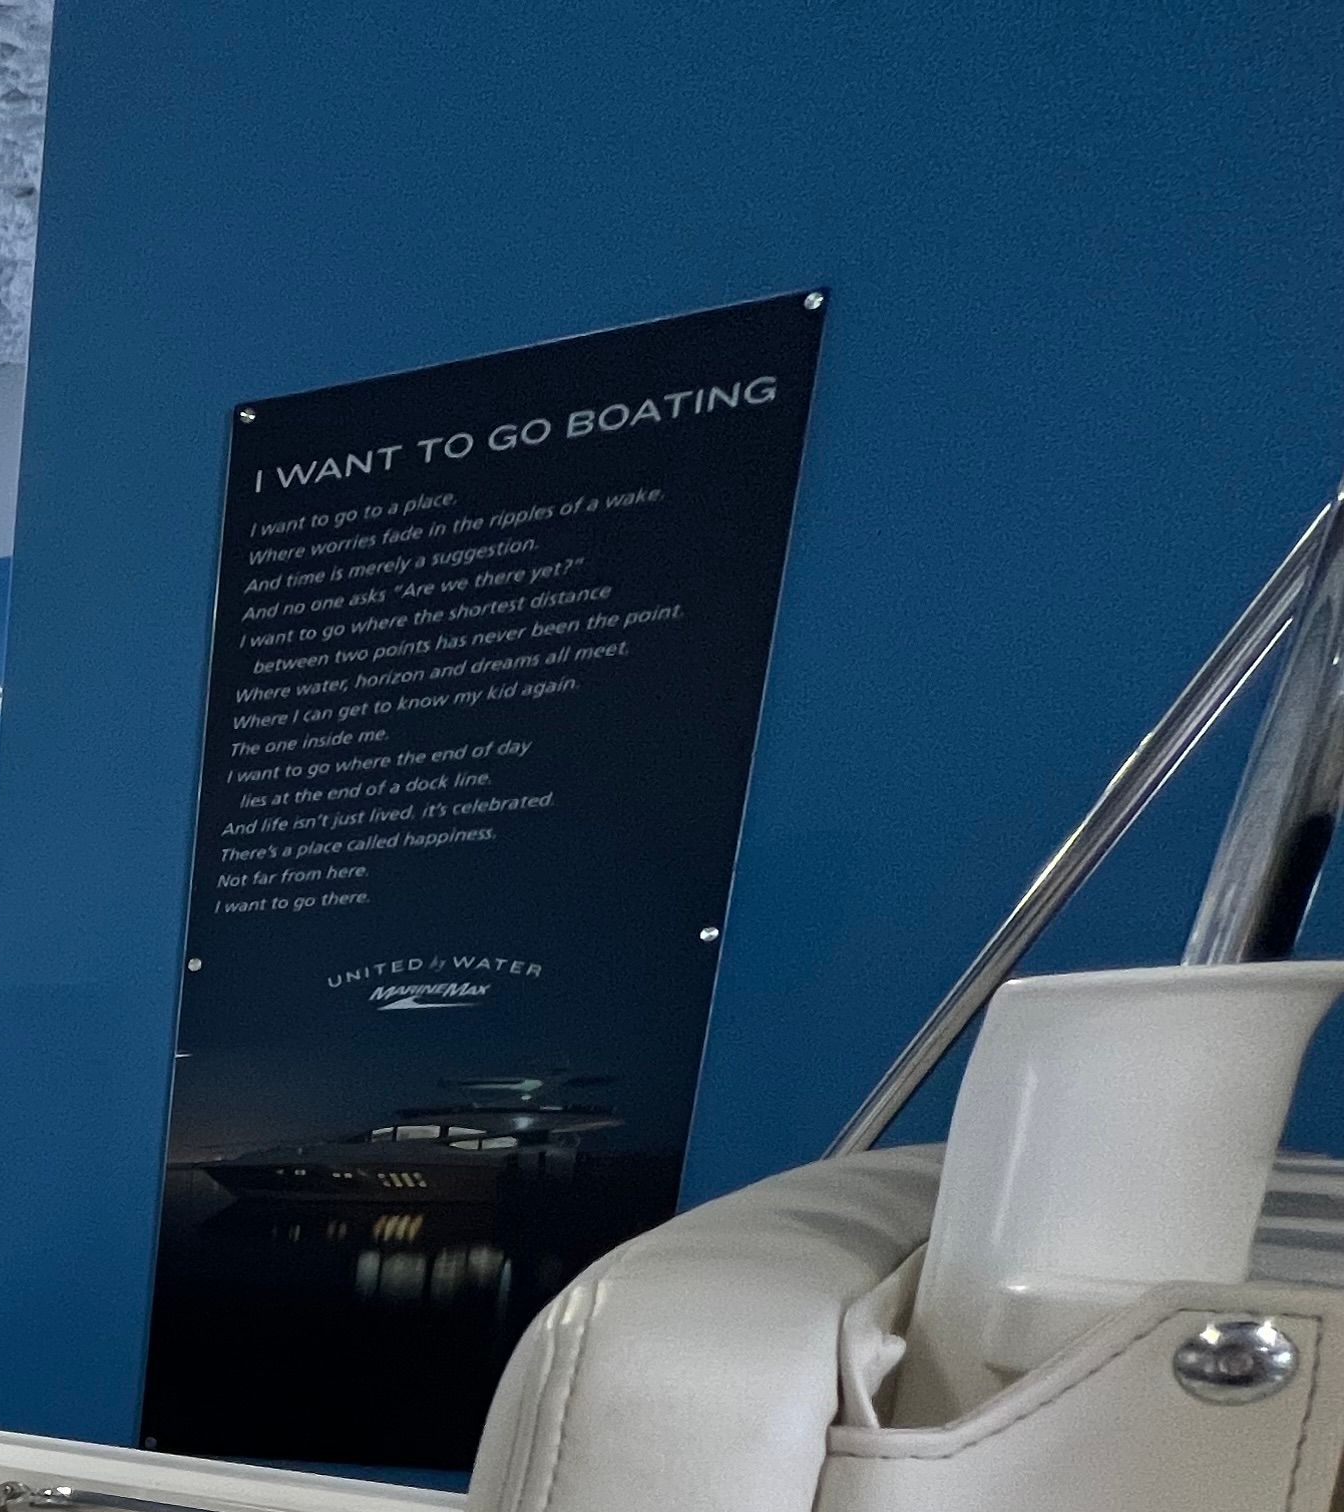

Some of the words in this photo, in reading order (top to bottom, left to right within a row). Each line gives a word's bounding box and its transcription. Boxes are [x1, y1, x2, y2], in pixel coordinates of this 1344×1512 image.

[255, 469, 263, 493] I
[276, 445, 403, 488] WANT
[417, 432, 474, 464] TO
[487, 418, 552, 451] GO
[566, 376, 777, 438] BOATING
[248, 545, 305, 566] Where
[310, 534, 376, 556] worries
[382, 525, 423, 546] fade
[428, 521, 446, 537] in
[453, 516, 484, 534] the
[489, 504, 554, 530] ripples
[559, 496, 585, 516] of
[586, 498, 599, 512] a
[250, 522, 258, 537] I
[262, 516, 306, 537] want
[311, 514, 330, 528] to
[334, 509, 358, 528] go
[364, 505, 382, 519] to
[387, 503, 399, 515] a
[244, 574, 281, 594] And
[286, 569, 325, 587] time
[330, 565, 343, 580] is
[348, 555, 411, 578] merely
[415, 556, 426, 568] a
[241, 602, 279, 622] And
[283, 602, 305, 616] no
[310, 595, 345, 612] one
[348, 588, 386, 607] asks
[441, 578, 468, 593] we
[474, 568, 526, 588] there
[239, 635, 246, 648] I
[250, 629, 294, 648] want
[299, 626, 317, 641] to
[322, 623, 345, 642] go
[351, 614, 408, 635] where
[413, 608, 444, 625] the
[448, 596, 526, 621] shortest
[530, 584, 613, 609] distance
[253, 653, 329, 674] between
[334, 649, 369, 664] two
[372, 639, 431, 662] points
[435, 633, 467, 650] has
[471, 626, 527, 646] never
[530, 619, 580, 638] been
[586, 612, 620, 630] the
[235, 685, 291, 703] Where
[354, 669, 424, 689] horizon
[429, 660, 467, 679] and
[470, 654, 540, 674] dreams
[544, 646, 571, 665] all
[233, 713, 288, 730] Where
[292, 709, 299, 723] I
[303, 708, 333, 723] can
[338, 701, 368, 722] get
[374, 699, 392, 714] to
[397, 695, 449, 711] know
[453, 689, 483, 707] my
[487, 681, 519, 700] kid
[227, 770, 233, 784] I
[237, 767, 280, 784] want
[285, 765, 303, 777] to
[307, 762, 330, 779] go
[335, 753, 391, 774] where
[396, 750, 426, 766] the
[431, 744, 469, 763] end
[471, 740, 495, 758] of
[497, 739, 533, 758] day
[231, 742, 260, 757] The
[264, 739, 297, 754] one
[302, 728, 353, 750] inside
[239, 793, 267, 809] lies
[271, 792, 289, 805] at
[294, 788, 323, 804] the
[327, 783, 362, 800] end
[365, 779, 388, 797] of
[389, 783, 400, 794] a
[405, 774, 448, 793] dock
[221, 819, 258, 837] And
[261, 815, 289, 833] life
[330, 811, 365, 830] just
[281, 845, 292, 858] a
[296, 840, 343, 859] place
[347, 832, 400, 850] called
[216, 874, 247, 889] Not
[252, 870, 276, 886] far
[280, 867, 322, 884] from
[214, 900, 221, 914] I
[224, 898, 265, 913] want
[271, 897, 289, 910] to
[294, 896, 316, 912] go
[327, 958, 424, 988] UNITED
[452, 956, 543, 977] WATER
